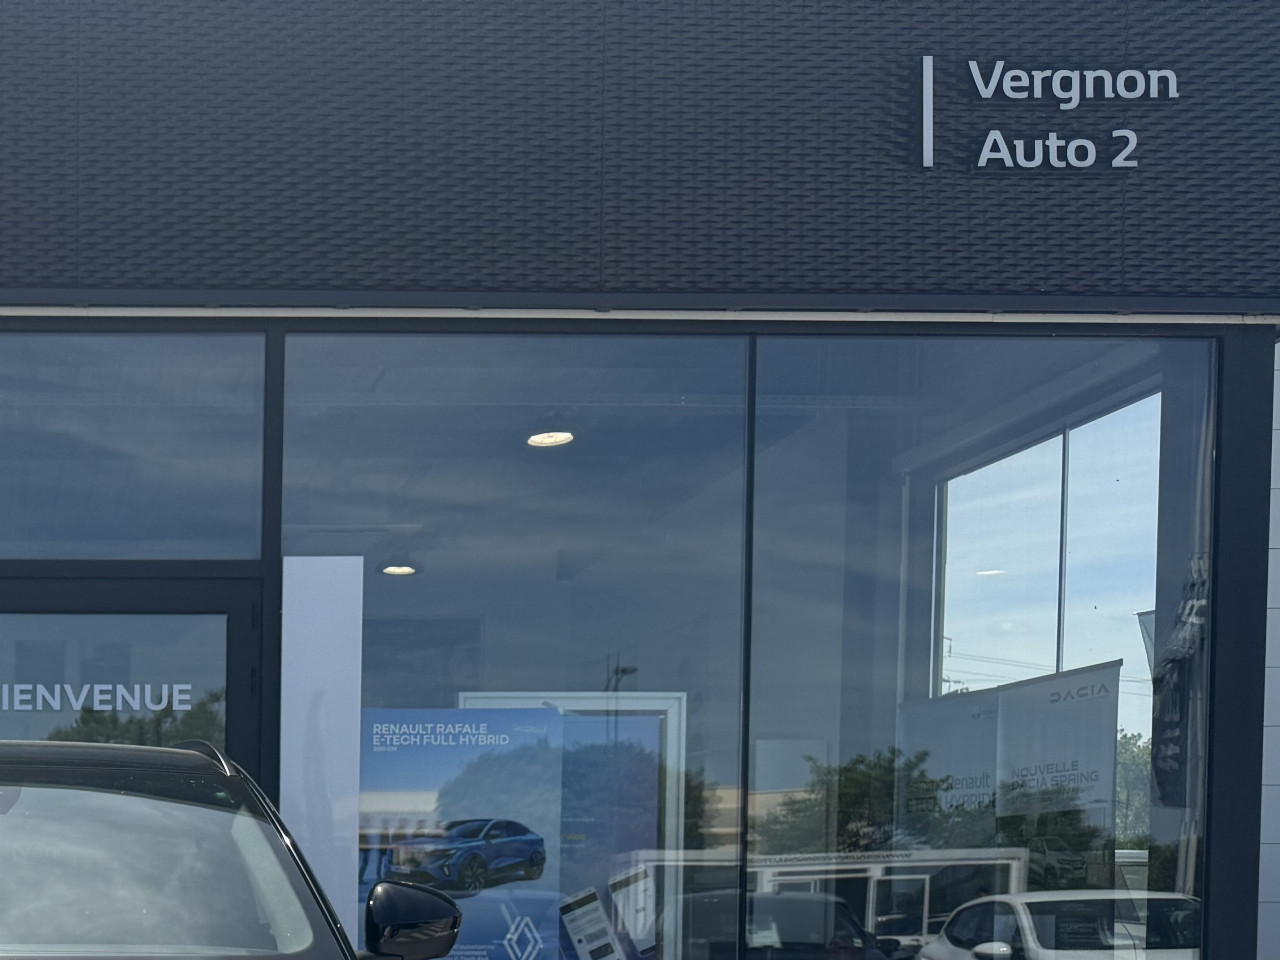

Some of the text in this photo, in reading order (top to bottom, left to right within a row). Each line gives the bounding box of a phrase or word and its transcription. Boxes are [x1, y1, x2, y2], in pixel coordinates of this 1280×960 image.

[968, 60, 1179, 110] Vergnon
[977, 129, 1138, 168] Auto 2
[1050, 683, 1109, 703] DACIA
[373, 723, 488, 734] RENAULT RAFALE
[373, 734, 509, 745] E-TECH FULL HYBRID
[1011, 760, 1079, 779] NOUVELLE
[1050, 770, 1099, 789] SPRING
